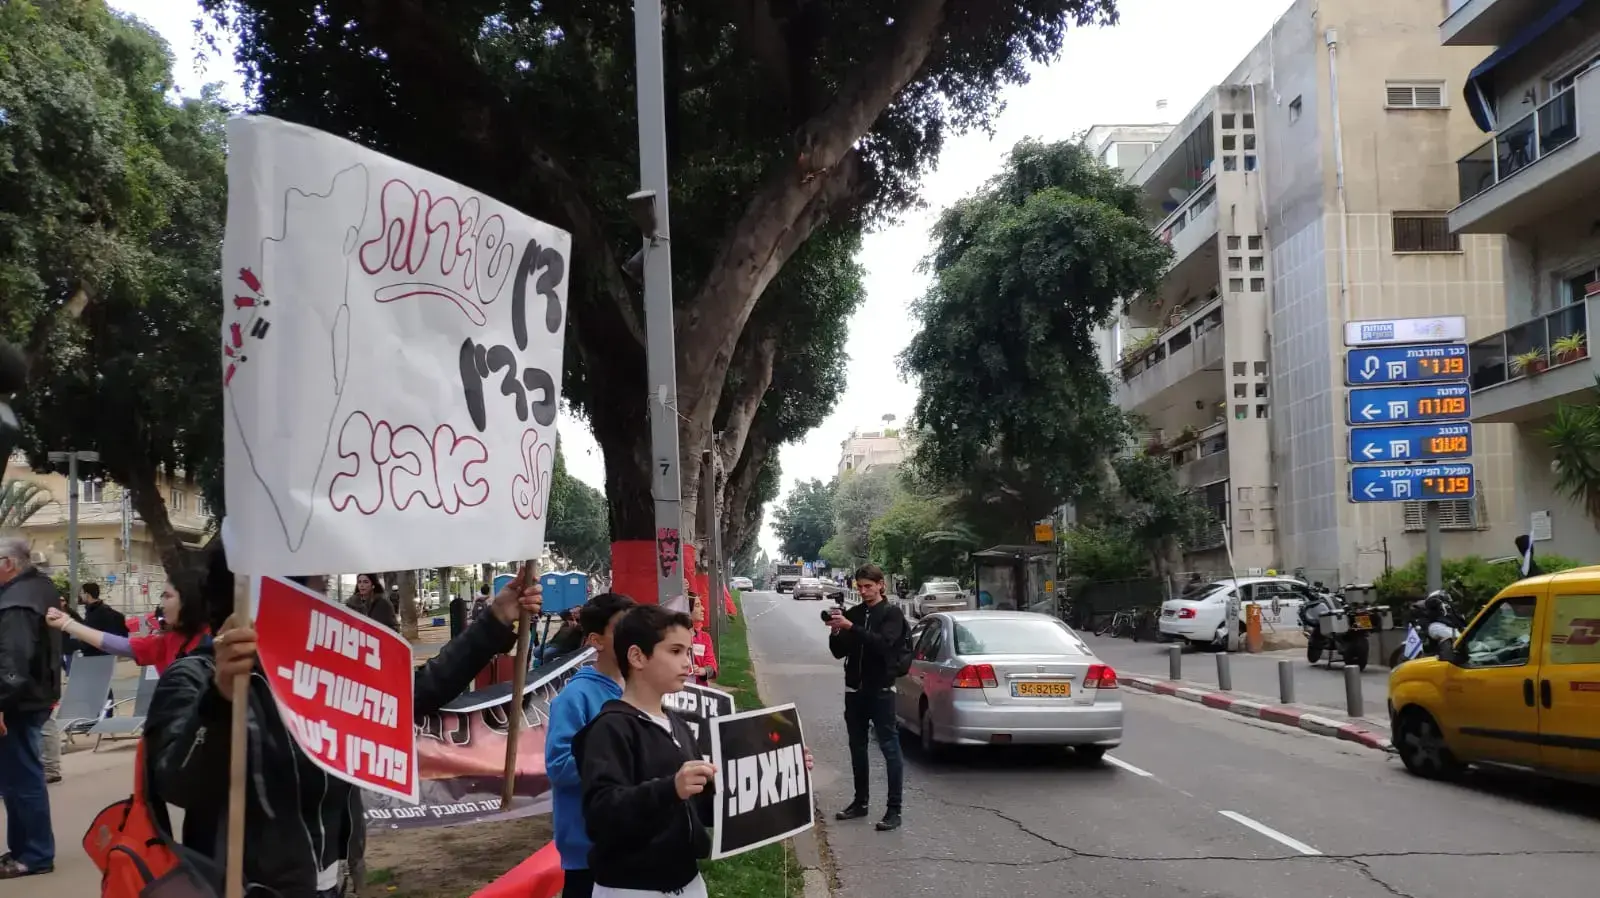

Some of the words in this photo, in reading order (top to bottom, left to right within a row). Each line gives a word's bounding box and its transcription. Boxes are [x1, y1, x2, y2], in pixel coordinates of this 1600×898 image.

[359, 178, 514, 305] שדרות
[511, 238, 565, 351] דין
[1406, 348, 1445, 358] התרבות
[1419, 357, 1464, 374] פנוי
[459, 337, 557, 433] כדין
[1437, 387, 1467, 396] שרונה
[1418, 397, 1465, 414] פתוח
[329, 410, 489, 515] אביב
[660, 464, 670, 476] 7
[1443, 466, 1471, 475] מפעל
[512, 428, 553, 520] תל
[1423, 477, 1469, 493] פנוי
[305, 609, 382, 671] ביטחון
[700, 695, 718, 719] אין
[345, 734, 408, 786] פתרון
[727, 743, 806, 818] נמאס!
[368, 808, 392, 819] עם
[430, 801, 480, 818] המאבק
